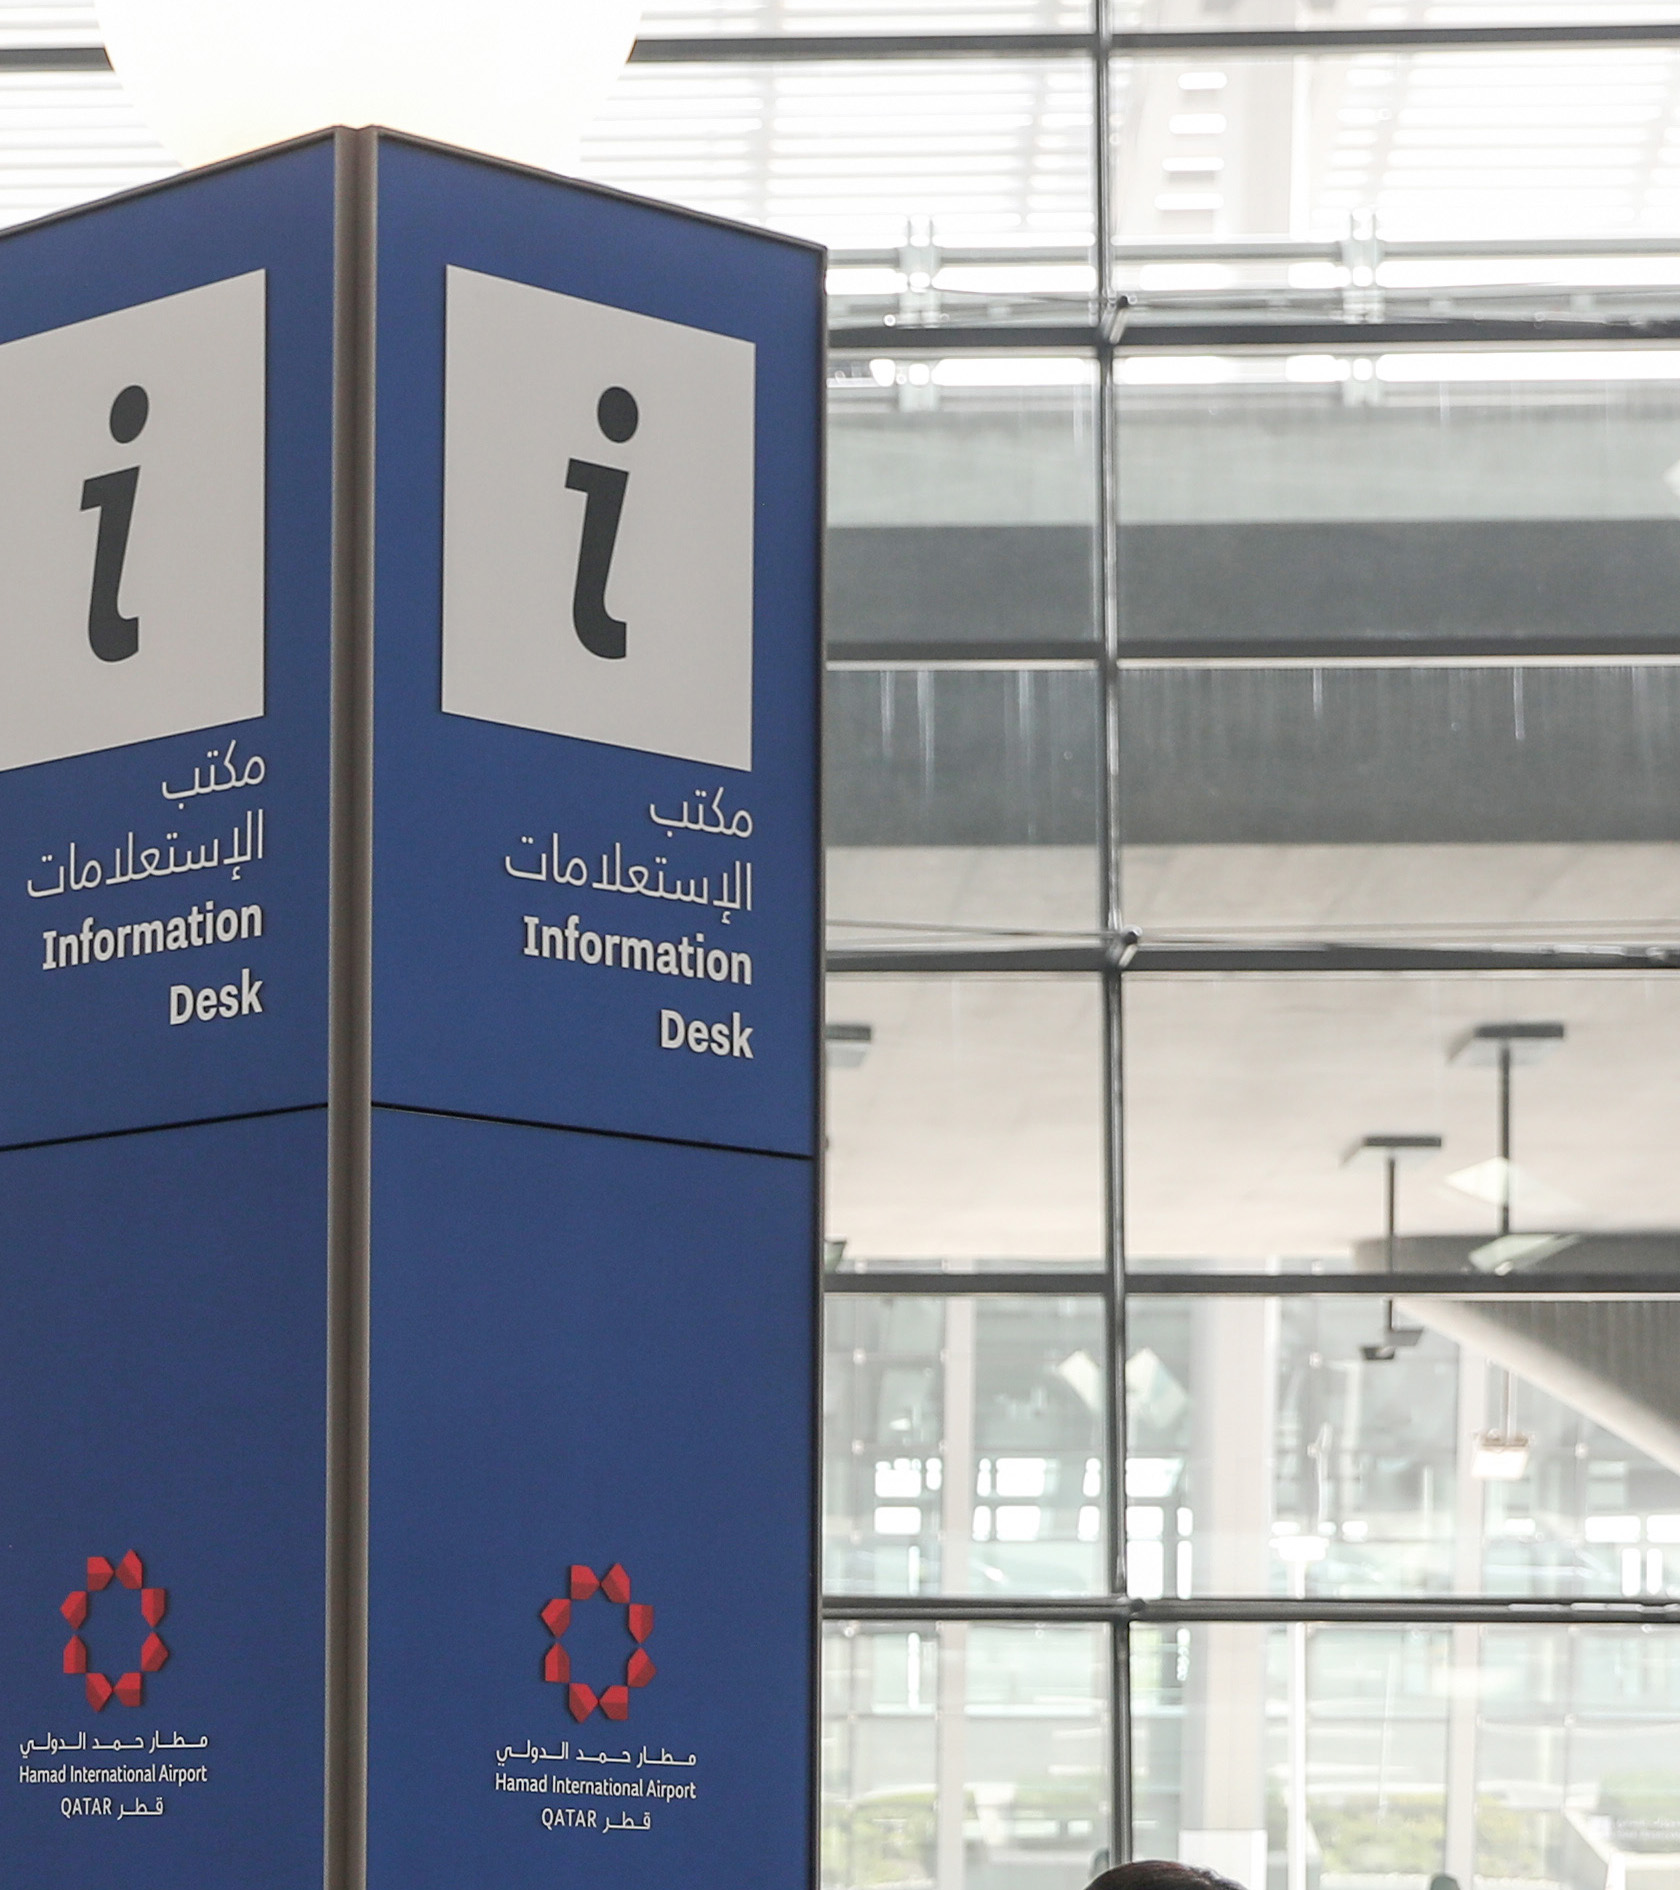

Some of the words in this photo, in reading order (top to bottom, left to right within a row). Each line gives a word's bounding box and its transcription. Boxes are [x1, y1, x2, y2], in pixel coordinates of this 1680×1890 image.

[161, 739, 266, 810] مكتب
[650, 787, 752, 837] مكتب
[27, 809, 265, 902] الإستعلامات
[505, 832, 753, 926] الإستعلامات
[42, 899, 263, 970] Information
[523, 914, 752, 987] Information
[169, 967, 263, 1026] Desk
[659, 1008, 754, 1060] Desk
[20, 1732, 85, 1758] الدولي
[92, 1737, 143, 1750] حمد
[149, 1731, 207, 1753] مطار
[497, 1740, 568, 1766] الدولي
[576, 1749, 630, 1763] حمد
[637, 1746, 696, 1768] مطار
[20, 1764, 66, 1782] Hamad
[71, 1764, 155, 1782] International
[159, 1764, 207, 1786] Airport
[496, 1773, 547, 1792] Hamad
[553, 1776, 643, 1796] International
[647, 1780, 696, 1802] Airport
[61, 1798, 111, 1818] QATAR
[117, 1797, 163, 1820] قطر
[542, 1808, 596, 1830] QATAR
[603, 1812, 650, 1833] قطر
